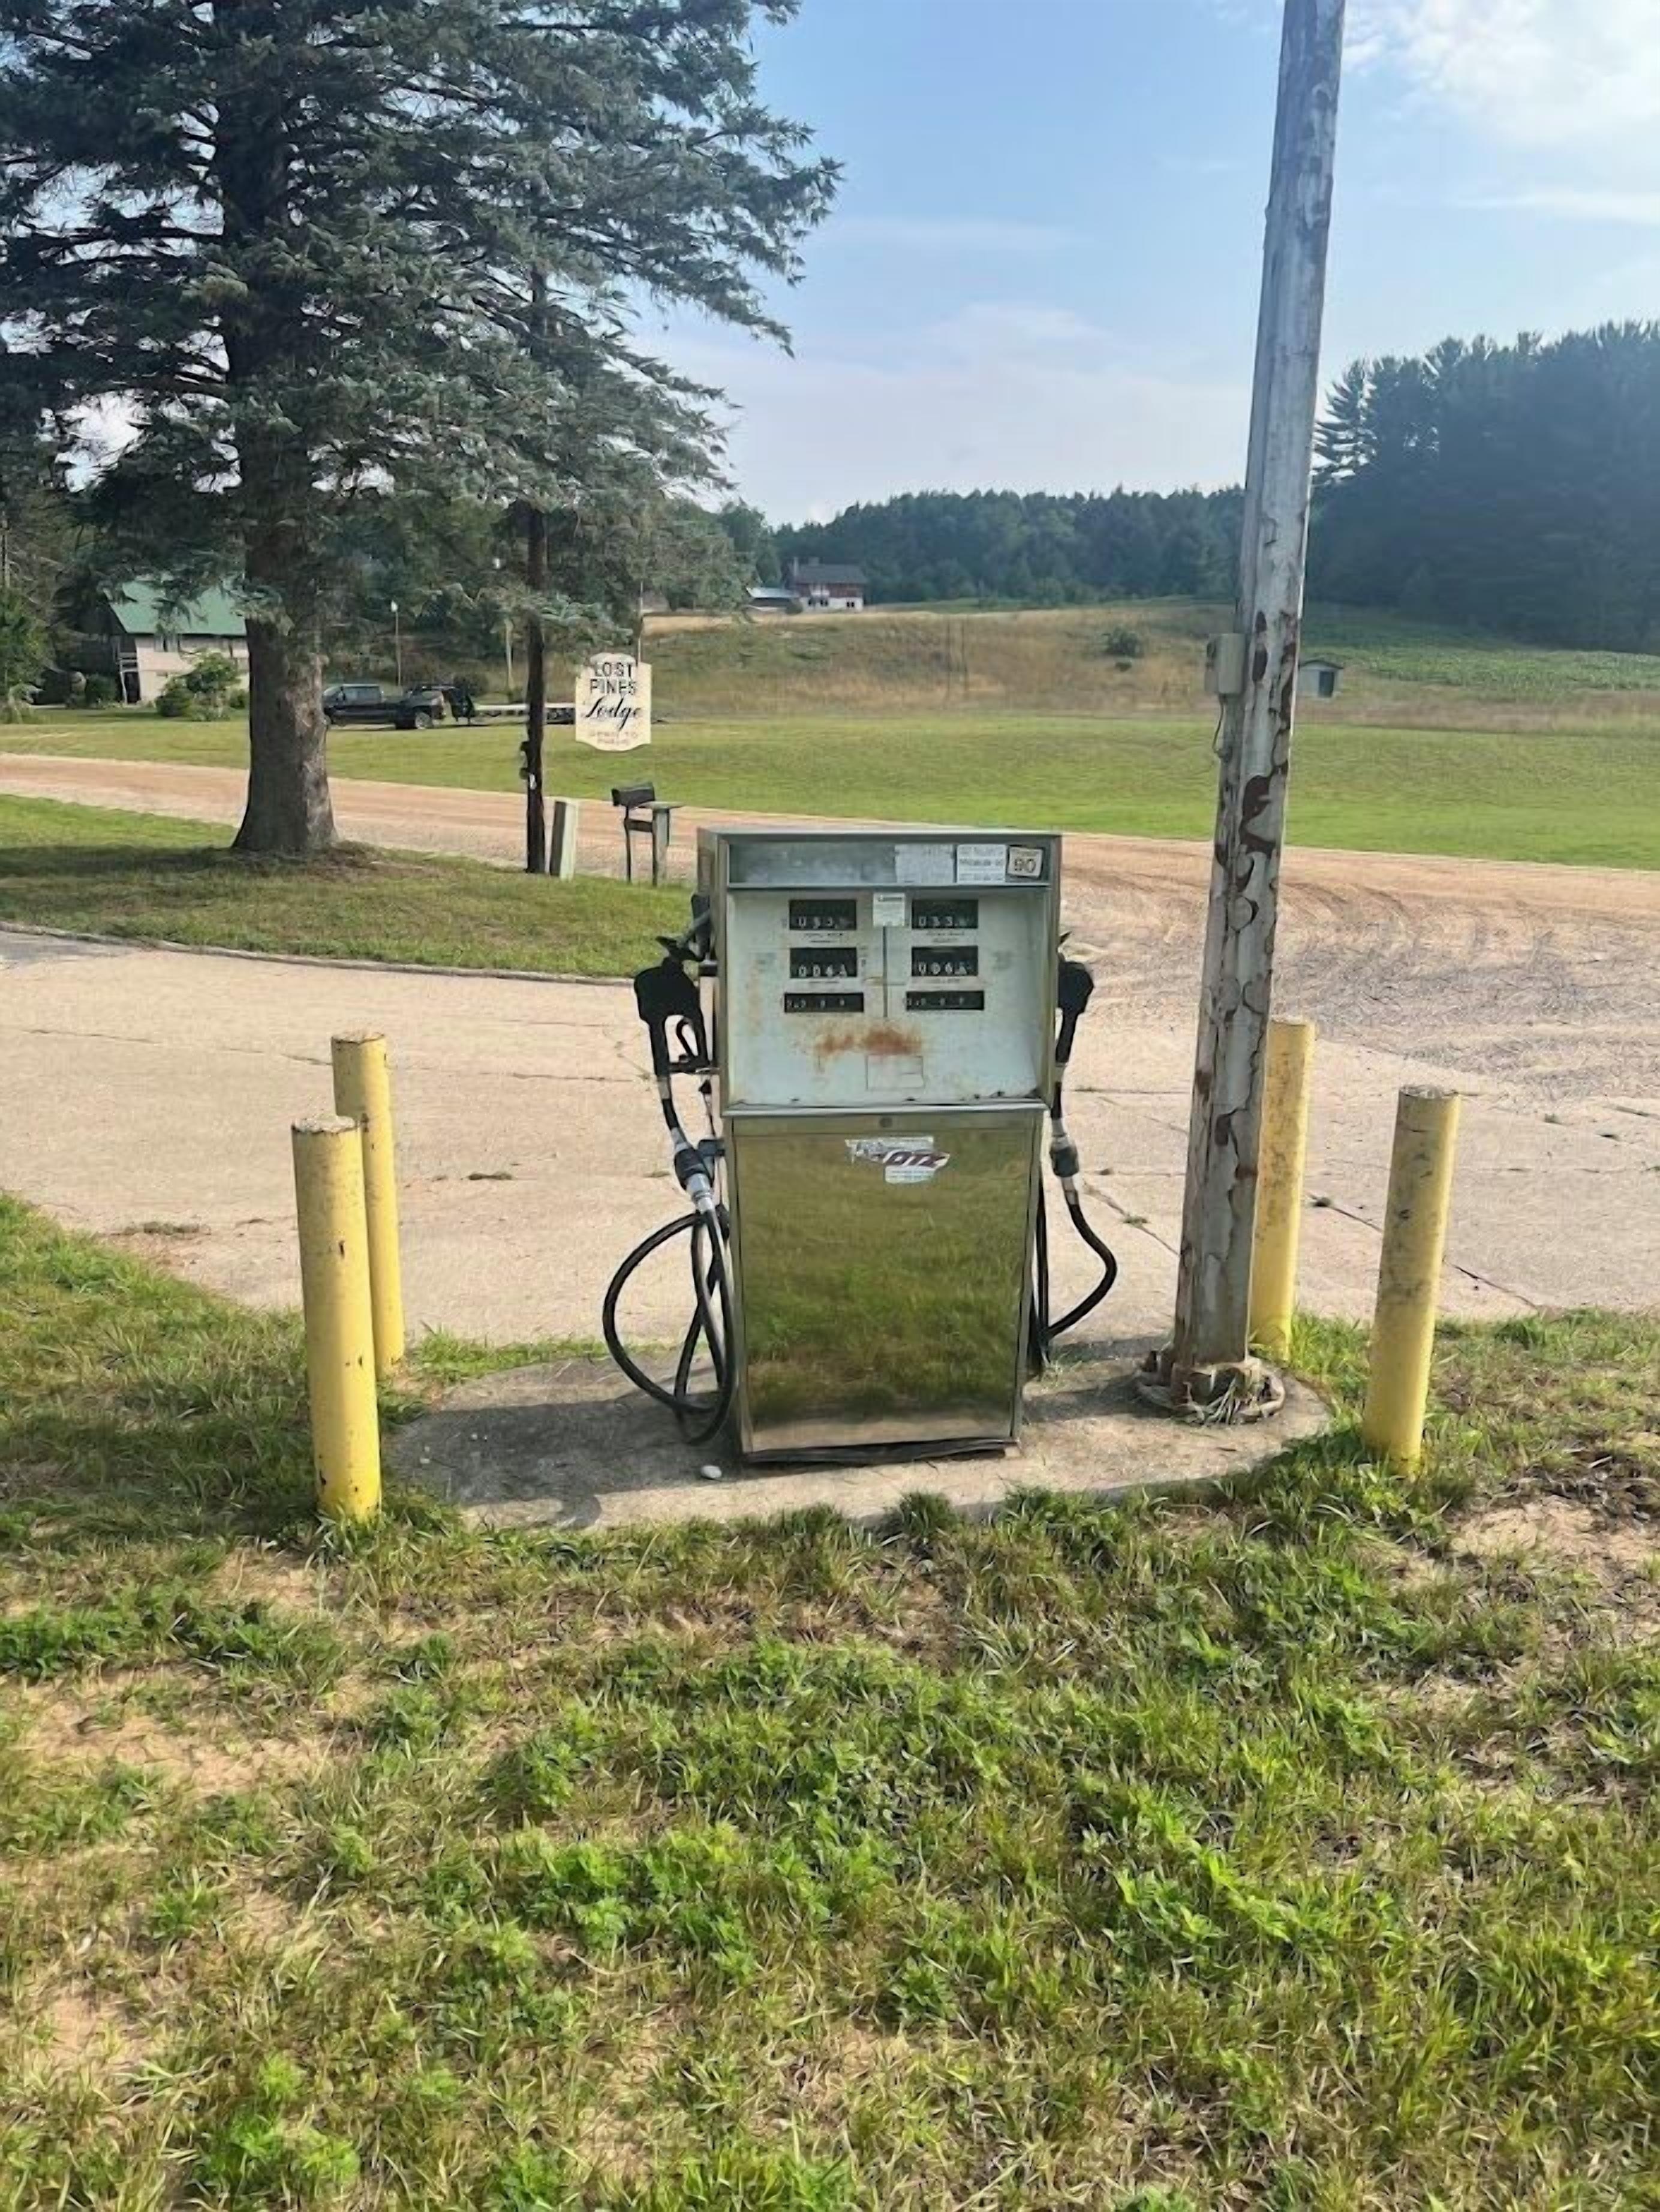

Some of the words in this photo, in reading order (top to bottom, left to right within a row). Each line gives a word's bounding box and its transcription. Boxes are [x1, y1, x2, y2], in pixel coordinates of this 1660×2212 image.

[594, 662, 633, 677] LOST
[590, 678, 636, 695] PINES
[581, 695, 642, 732] Lodge
